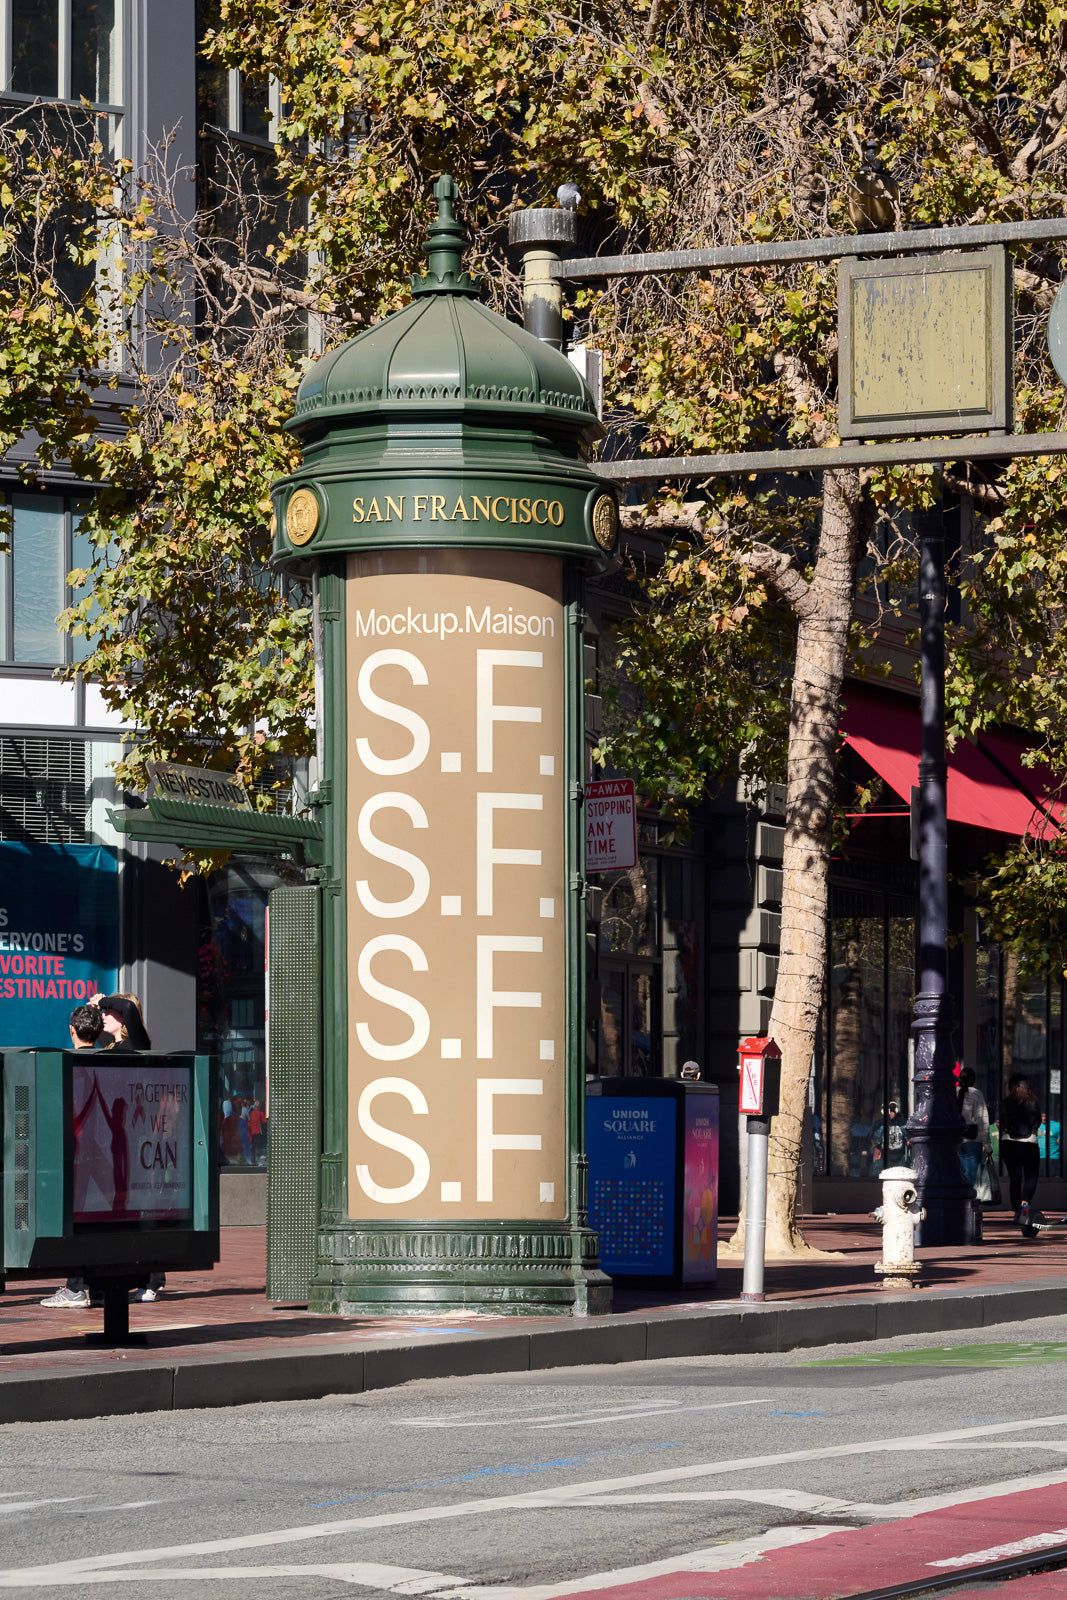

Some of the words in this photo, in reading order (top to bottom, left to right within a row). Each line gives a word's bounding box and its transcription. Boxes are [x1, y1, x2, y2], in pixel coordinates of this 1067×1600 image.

[352, 496, 406, 523] SAN
[412, 494, 565, 526] FRANCISCO
[356, 605, 555, 640] Mockup.Maison
[356, 648, 555, 776] S.F.
[155, 771, 245, 804] NEWSSTAND
[588, 799, 631, 817] STOPPING
[588, 821, 613, 837] ANY
[356, 791, 555, 919] S.F.
[586, 838, 616, 855] TIME
[0, 954, 65, 975] VORITE
[356, 933, 555, 1061] S.F.
[748, 1061, 759, 1086] FIRE
[150, 1114, 168, 1133] WE
[603, 1119, 657, 1134] SQUARE
[612, 1110, 649, 1119] UNION
[356, 1076, 555, 1204] S.F.
[140, 1141, 177, 1170] CAN
